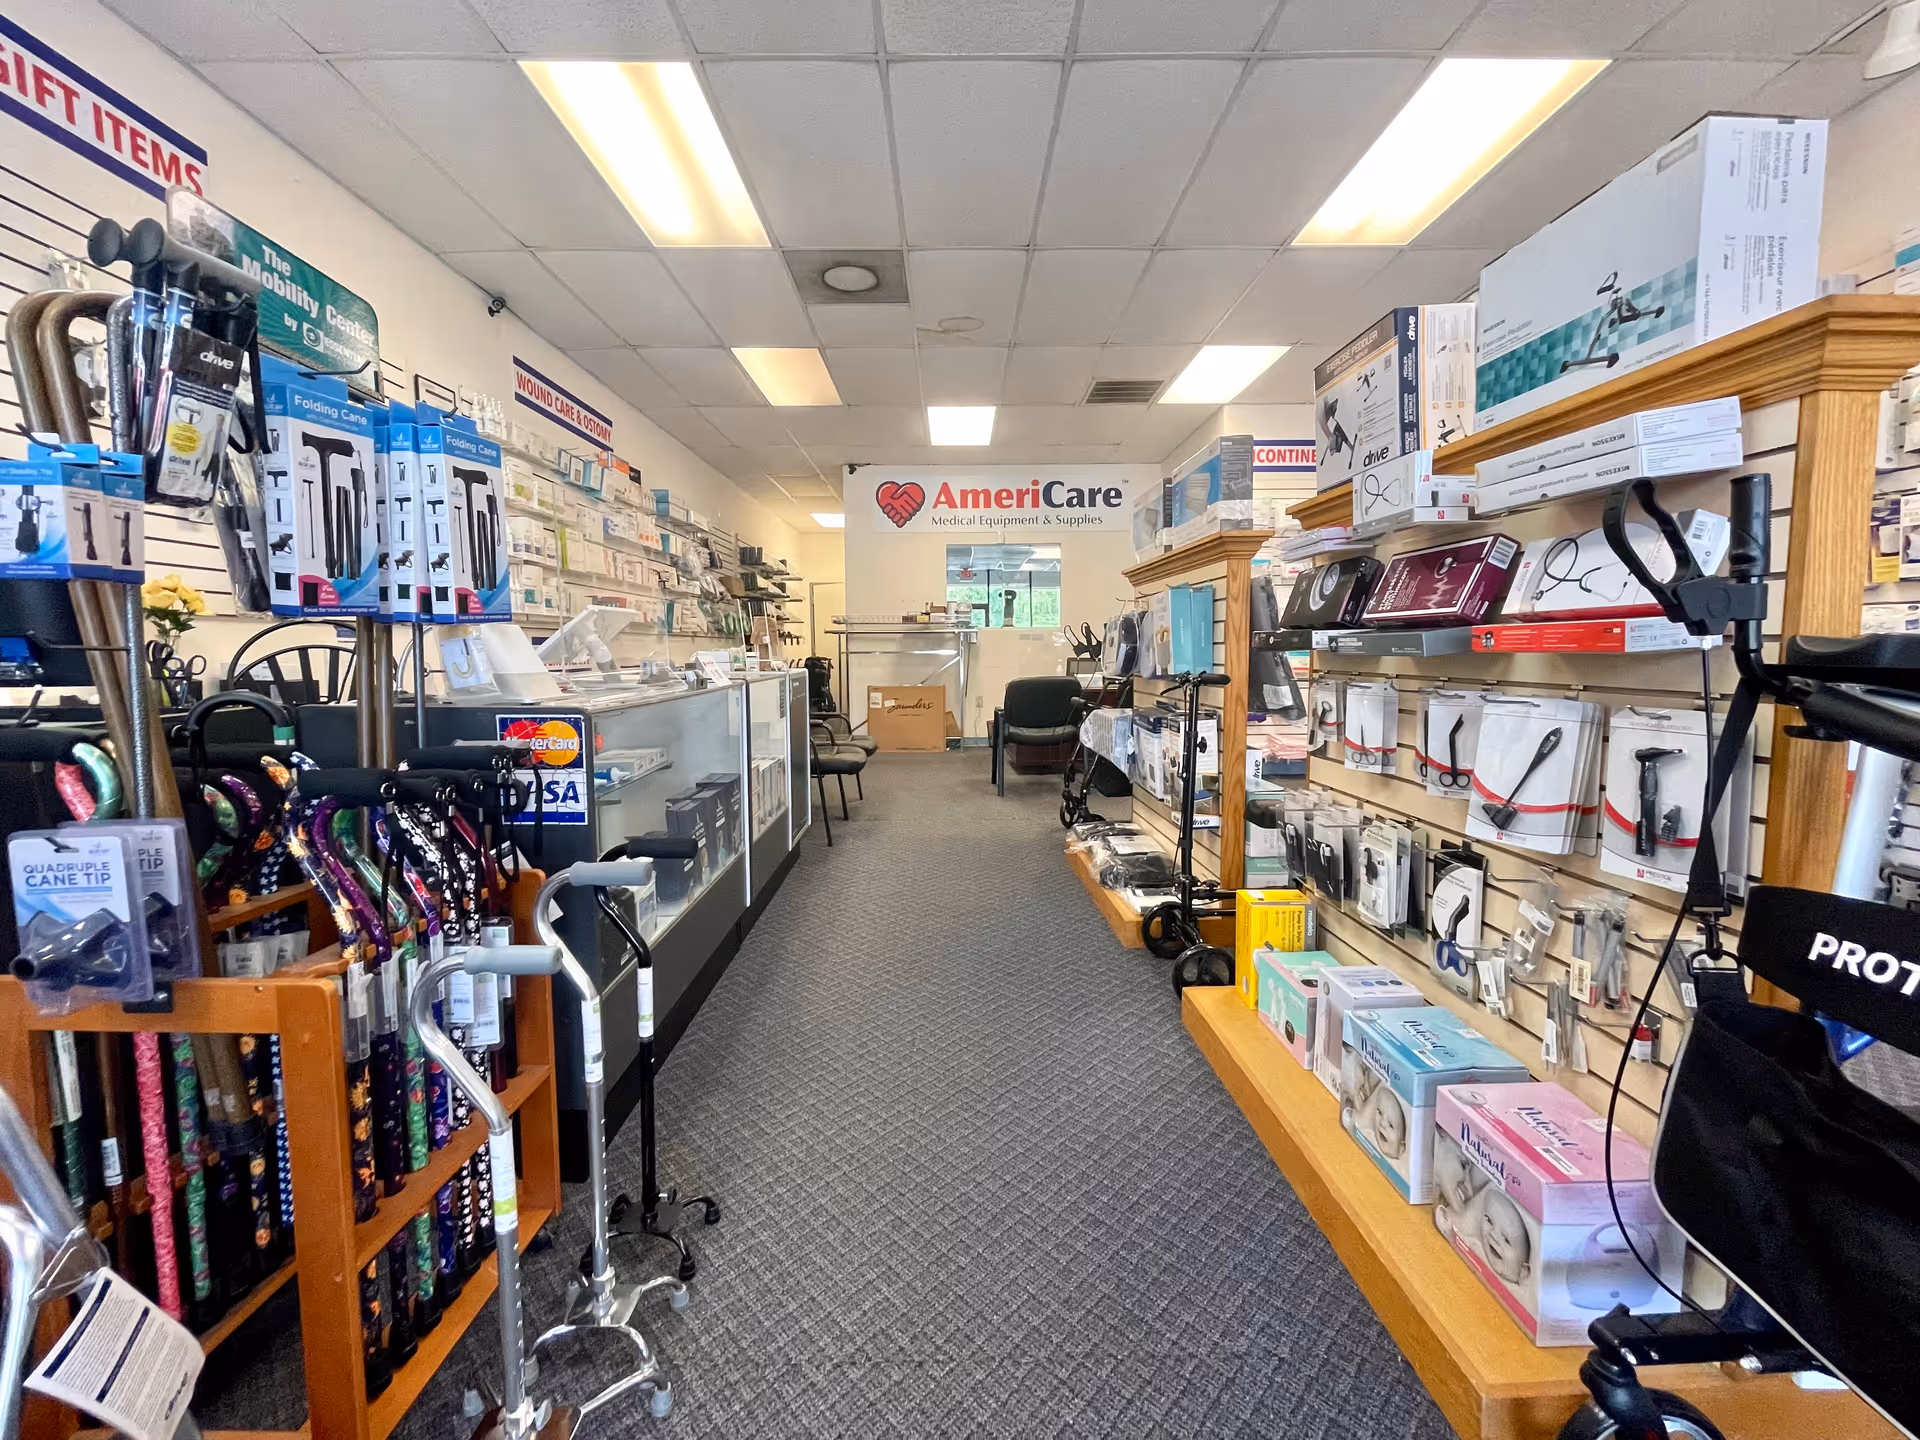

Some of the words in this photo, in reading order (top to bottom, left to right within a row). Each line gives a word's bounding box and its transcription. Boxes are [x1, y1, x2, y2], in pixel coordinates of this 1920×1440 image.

[92, 101, 204, 196] ITEMS
[1780, 180, 1791, 203] para
[262, 244, 291, 277] The
[1777, 236, 1788, 286] Exerciseur
[241, 254, 320, 319] Mobility
[326, 304, 375, 348] Center
[1775, 290, 1785, 312] avec
[284, 313, 298, 331] by
[1406, 315, 1416, 341] drive
[200, 351, 235, 370] drive
[1326, 349, 1352, 374] EXERCISE
[1351, 330, 1378, 358] PEDDLER
[294, 395, 339, 420] Folding
[341, 409, 368, 426] Cane
[516, 370, 553, 407] WOUND
[554, 396, 575, 422] CARE
[576, 409, 582, 427] &
[583, 414, 611, 443] OSTOMY
[446, 434, 477, 453] Folding
[477, 442, 498, 458] Cane
[1363, 446, 1389, 468] drive
[932, 479, 1123, 509] AmeriCare
[931, 514, 976, 526] Medical
[979, 514, 1040, 528] Equipment
[1043, 515, 1052, 525] &
[1055, 513, 1103, 528] Supplies
[24, 861, 111, 874] QUADRUPLE
[138, 858, 164, 870] TIP
[25, 873, 79, 888] CANE
[83, 872, 112, 886] TIP
[1403, 1019, 1447, 1051] Natural
[1360, 1035, 1394, 1078] Natural
[1516, 1106, 1580, 1148] Natural
[1460, 1121, 1508, 1180] Natural
